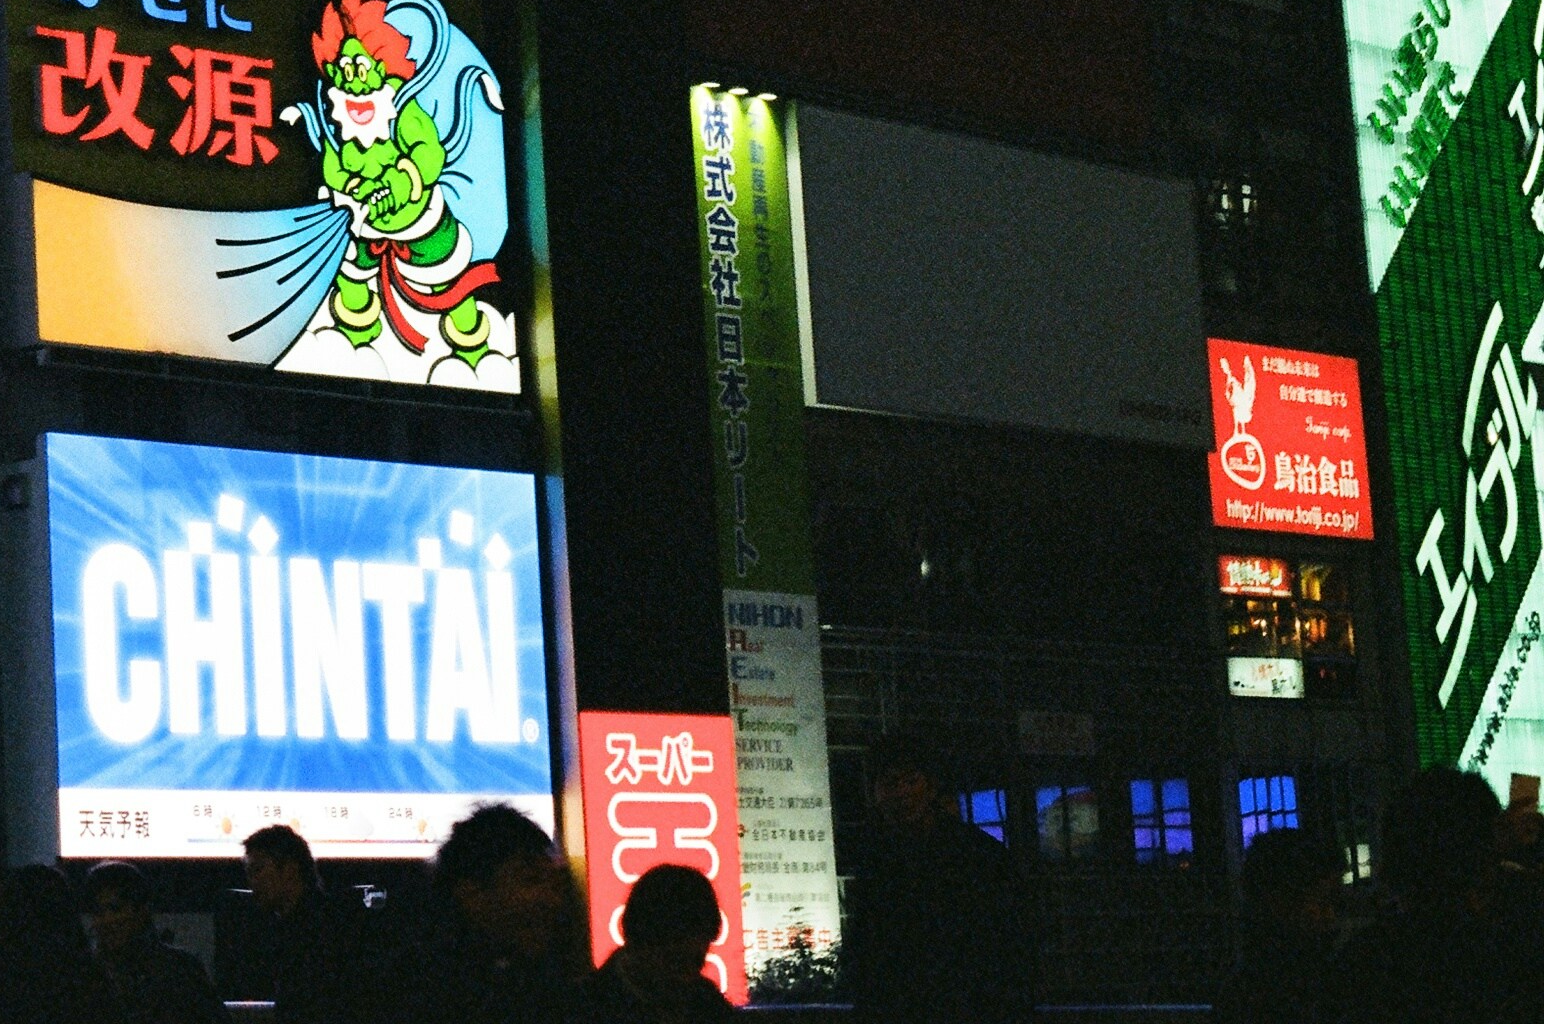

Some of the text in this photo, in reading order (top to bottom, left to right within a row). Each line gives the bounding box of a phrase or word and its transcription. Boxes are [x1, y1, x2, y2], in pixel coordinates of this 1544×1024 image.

[36, 25, 281, 168] 改源
[702, 98, 761, 578] 株式会社日本リート
[1274, 451, 1360, 499] 鳥治食品
[1415, 341, 1539, 646] エイブル
[83, 541, 522, 744] CHINTAI
[78, 810, 151, 839] 天気予報
[605, 732, 715, 786] スーパー
